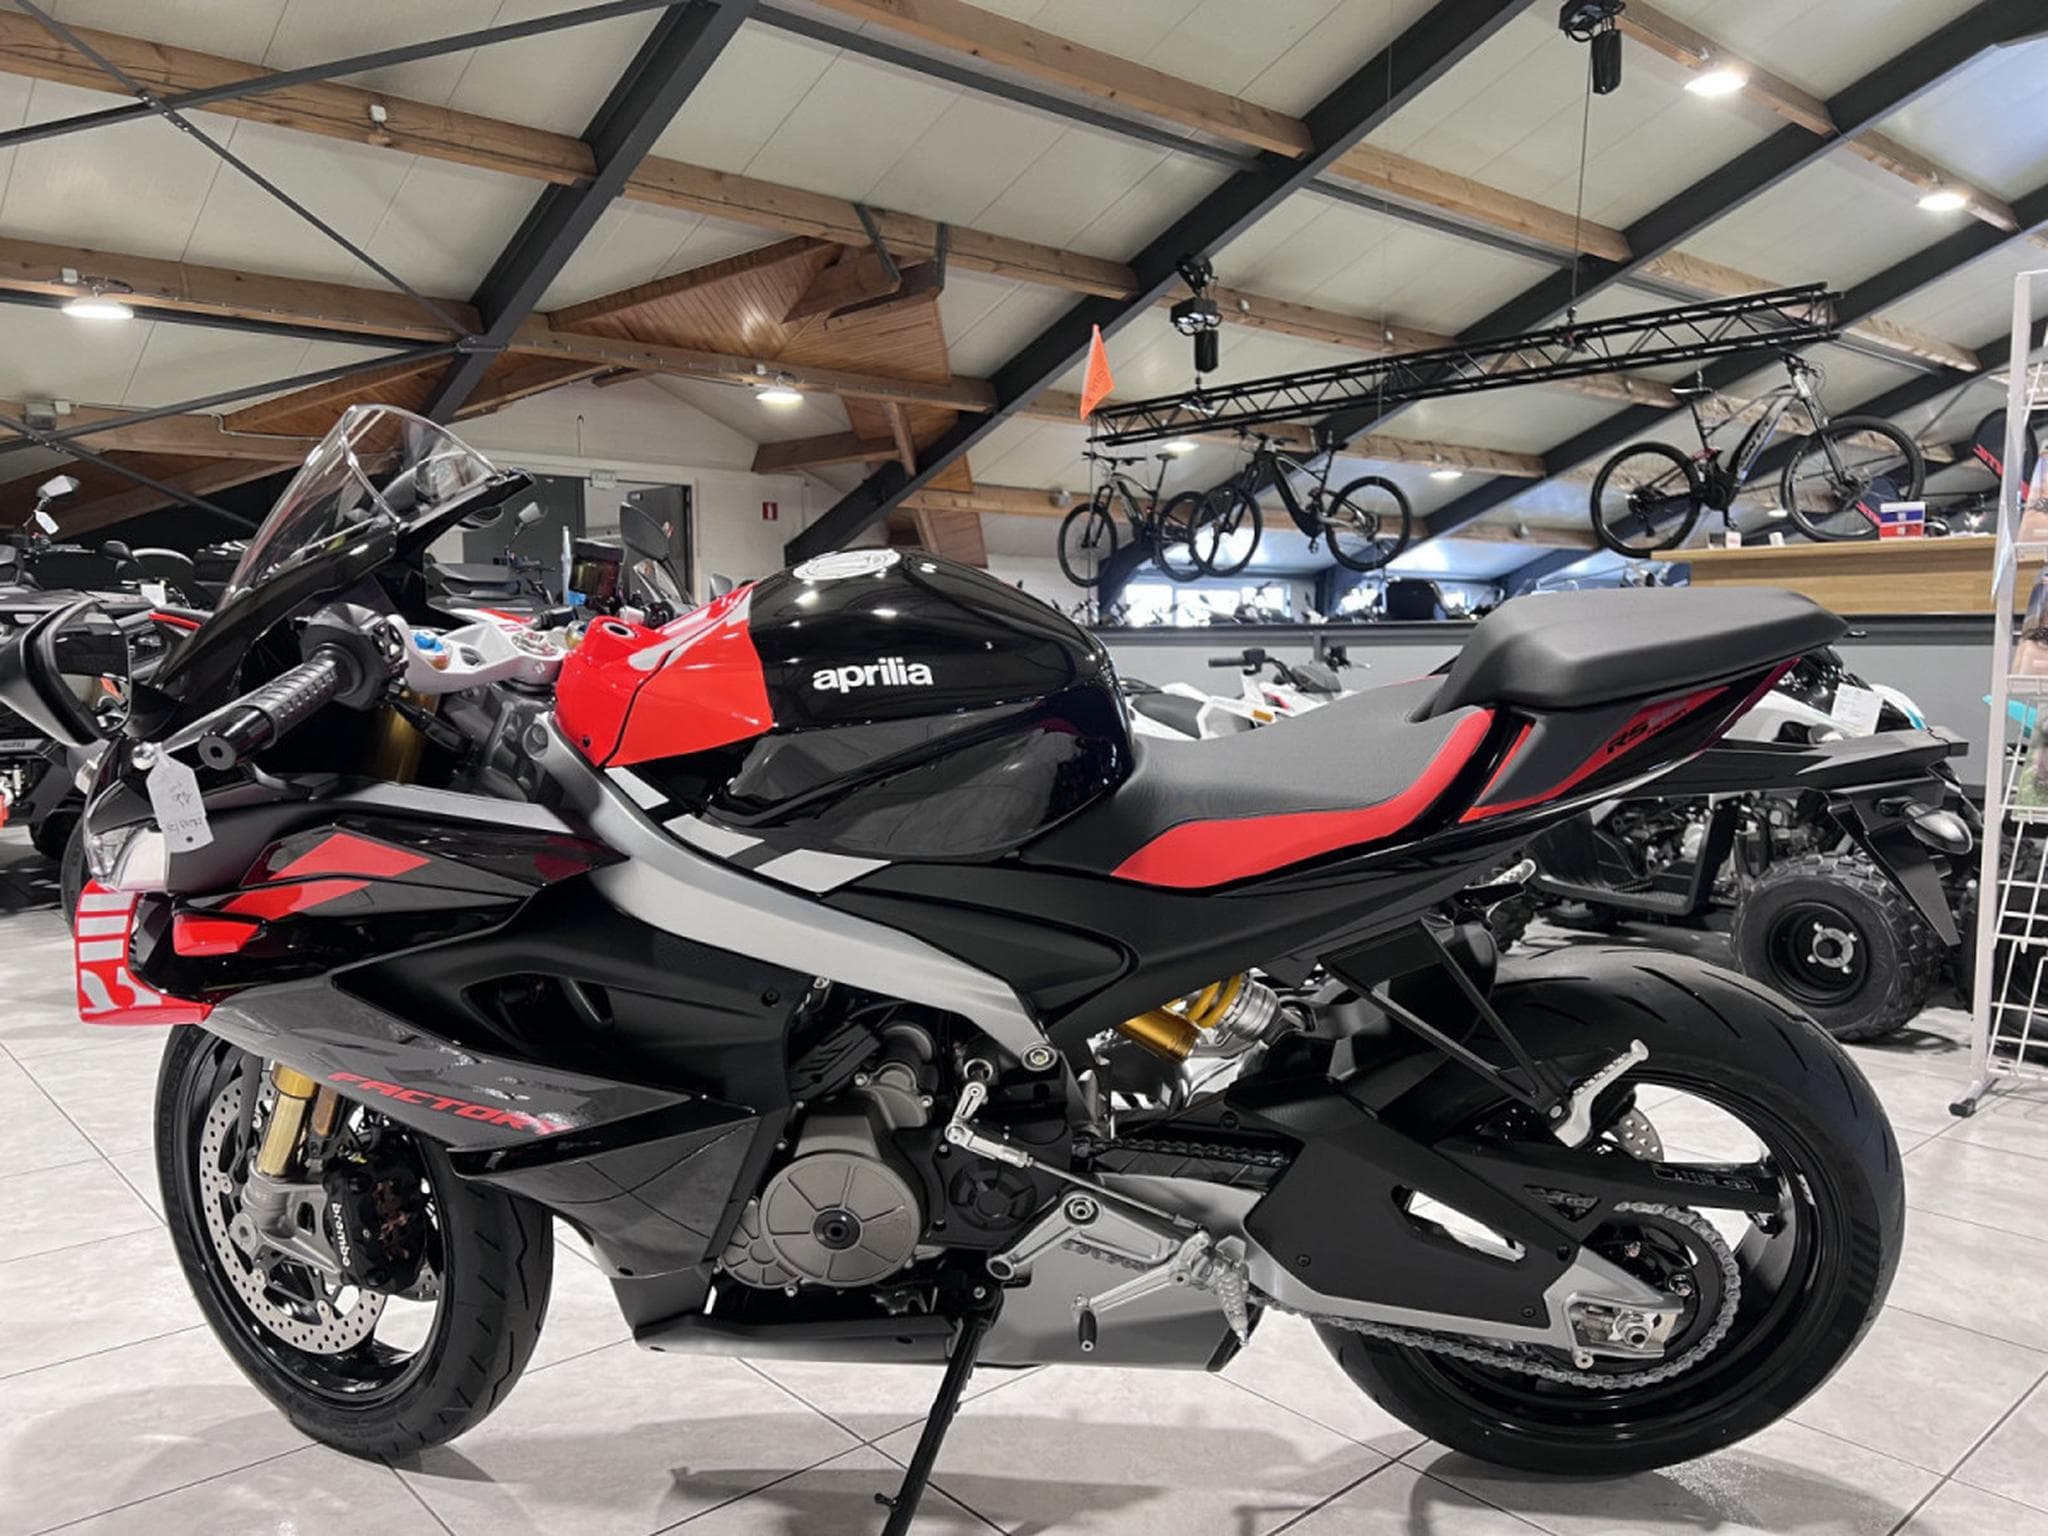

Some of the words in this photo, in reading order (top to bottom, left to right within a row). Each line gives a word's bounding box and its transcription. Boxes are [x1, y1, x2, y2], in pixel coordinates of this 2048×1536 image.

[812, 657, 934, 693] aprilia
[328, 1071, 575, 1135] FACTORY
[331, 1202, 351, 1267] brembo
